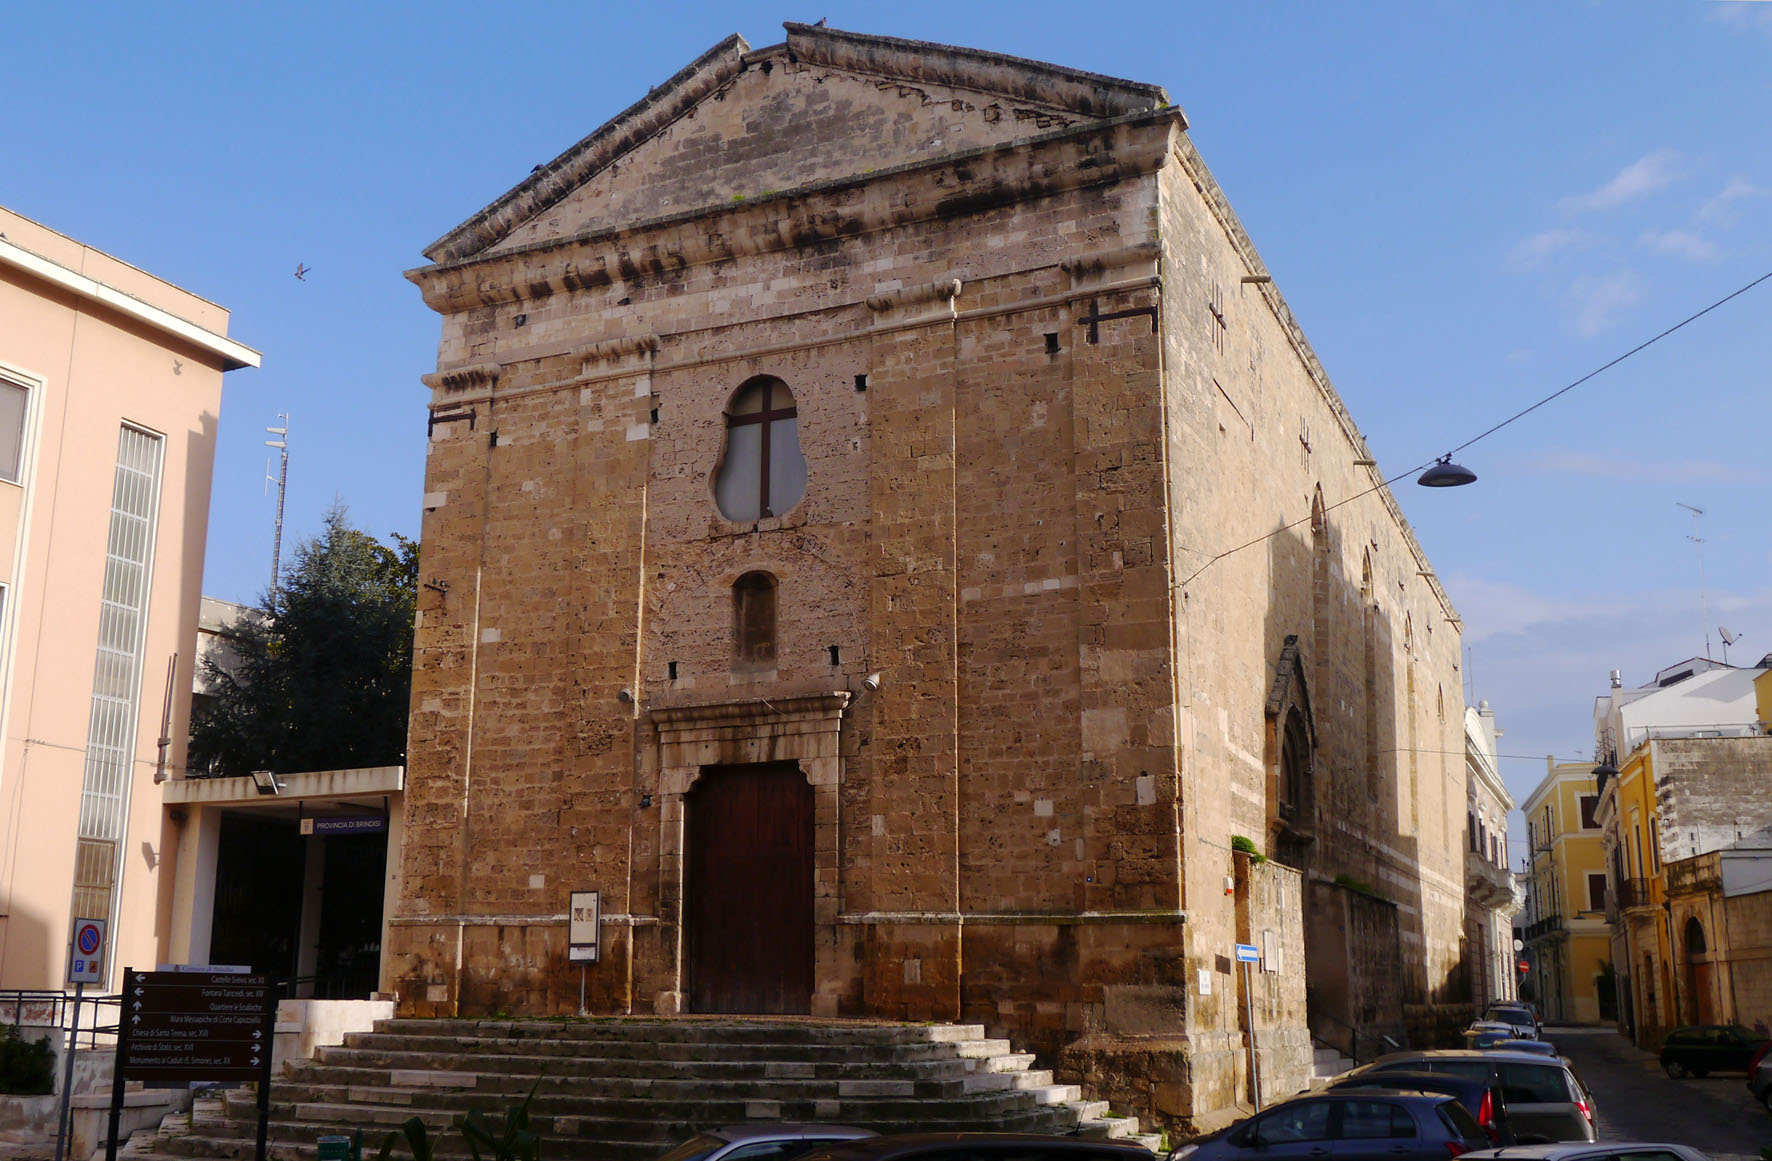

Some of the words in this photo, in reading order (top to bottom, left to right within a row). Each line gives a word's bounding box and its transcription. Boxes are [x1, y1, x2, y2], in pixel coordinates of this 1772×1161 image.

[316, 822, 348, 830] PROVINCIA
[355, 820, 381, 828] BRINDISI
[76, 961, 82, 971] P
[202, 989, 222, 998] Fontana
[170, 1015, 183, 1023] Mura
[184, 1015, 213, 1025] Messapiche
[218, 1015, 232, 1024] Corte
[132, 1028, 148, 1037] Chiesa
[149, 1028, 155, 1037] di
[155, 1028, 170, 1037] Santa
[129, 1055, 161, 1064] Monumento
[167, 1055, 183, 1064] Caduti
